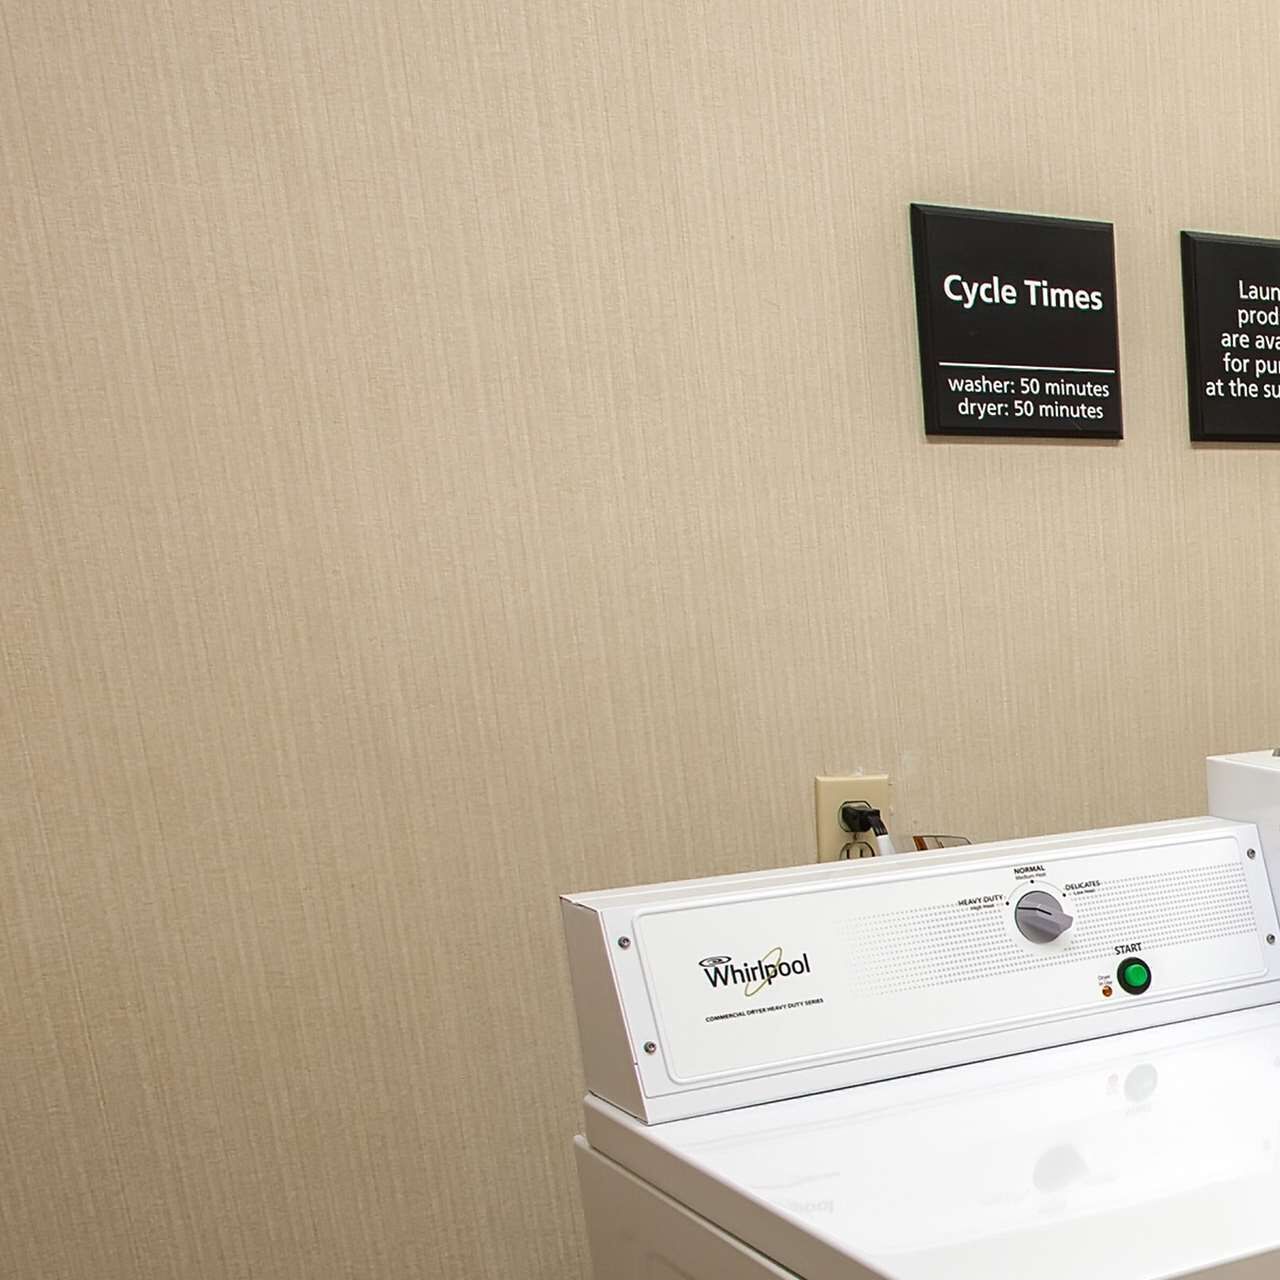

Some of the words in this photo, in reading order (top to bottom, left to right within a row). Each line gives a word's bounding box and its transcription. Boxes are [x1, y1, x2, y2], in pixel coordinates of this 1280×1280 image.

[943, 274, 1017, 309] Cycle
[1024, 279, 1103, 310] Times
[1221, 332, 1249, 348] are
[1223, 352, 1249, 373] for
[948, 375, 1015, 394] washer:
[1020, 378, 1040, 394] 50
[1045, 379, 1109, 397] minutes
[1206, 379, 1224, 396] at
[1228, 378, 1258, 397] the
[958, 397, 1009, 420] dryer:
[1014, 400, 1034, 416] 50
[1039, 401, 1104, 419] minutes
[1014, 865, 1045, 875] NORMAL
[1065, 880, 1100, 891] DELICATES
[958, 896, 982, 906] HEAVY
[983, 894, 1004, 903] DUTY
[1114, 942, 1142, 955] START
[704, 953, 810, 987] Whirlpool
[705, 1011, 746, 1022] COMMERCIAL
[746, 1007, 766, 1016] DRYER
[767, 1003, 787, 1012] HEAVY
[787, 1001, 804, 1009] DUTY
[804, 998, 824, 1006] SERIES
